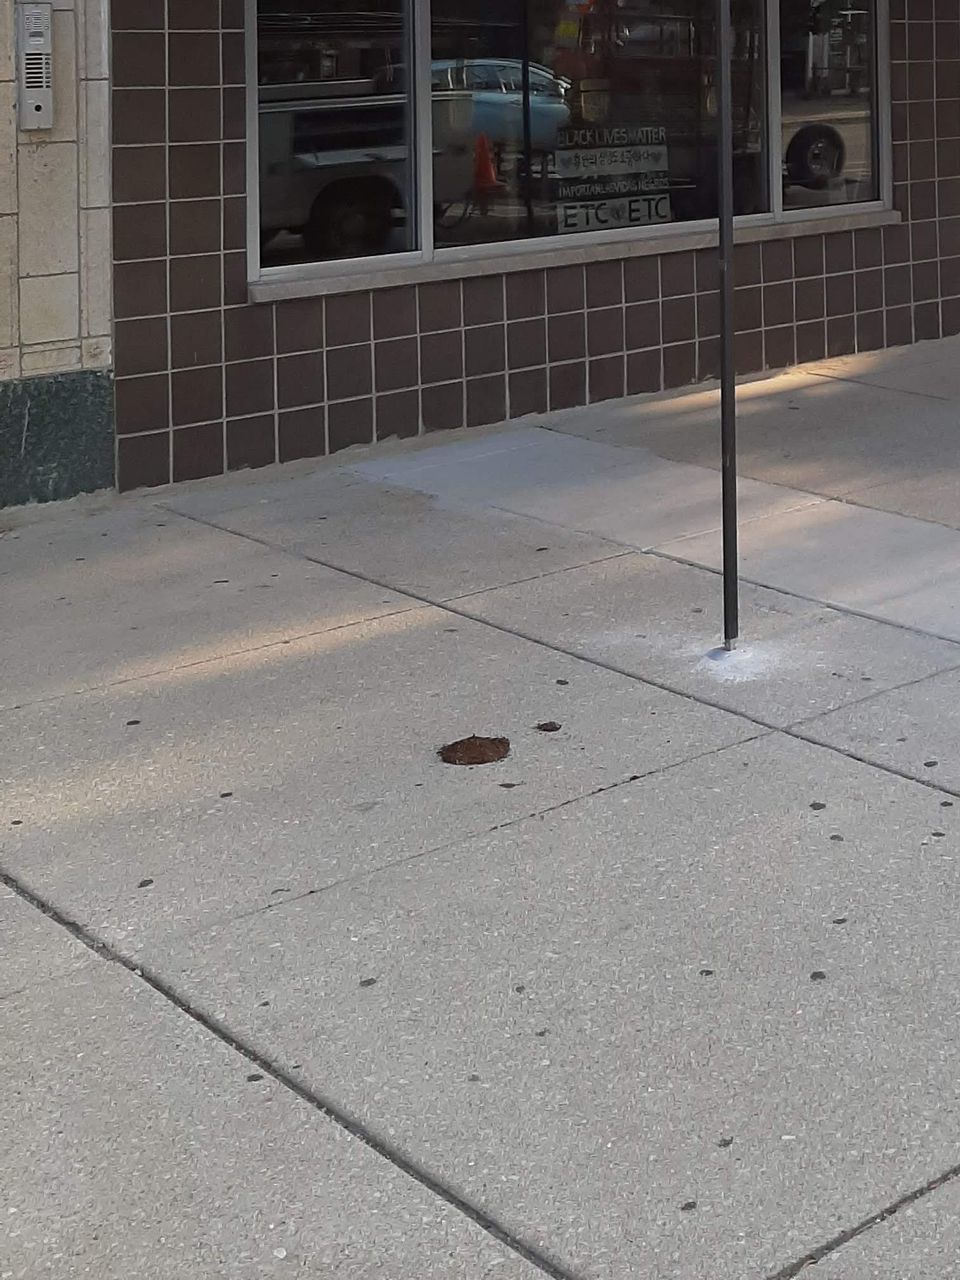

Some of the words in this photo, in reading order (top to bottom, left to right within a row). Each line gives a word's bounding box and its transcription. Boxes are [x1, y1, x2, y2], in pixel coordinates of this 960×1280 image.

[558, 128, 594, 146] BLACK
[595, 128, 627, 145] LIVES
[628, 127, 666, 144] MATTER
[563, 202, 608, 228] ETC
[628, 196, 668, 222] ETC
